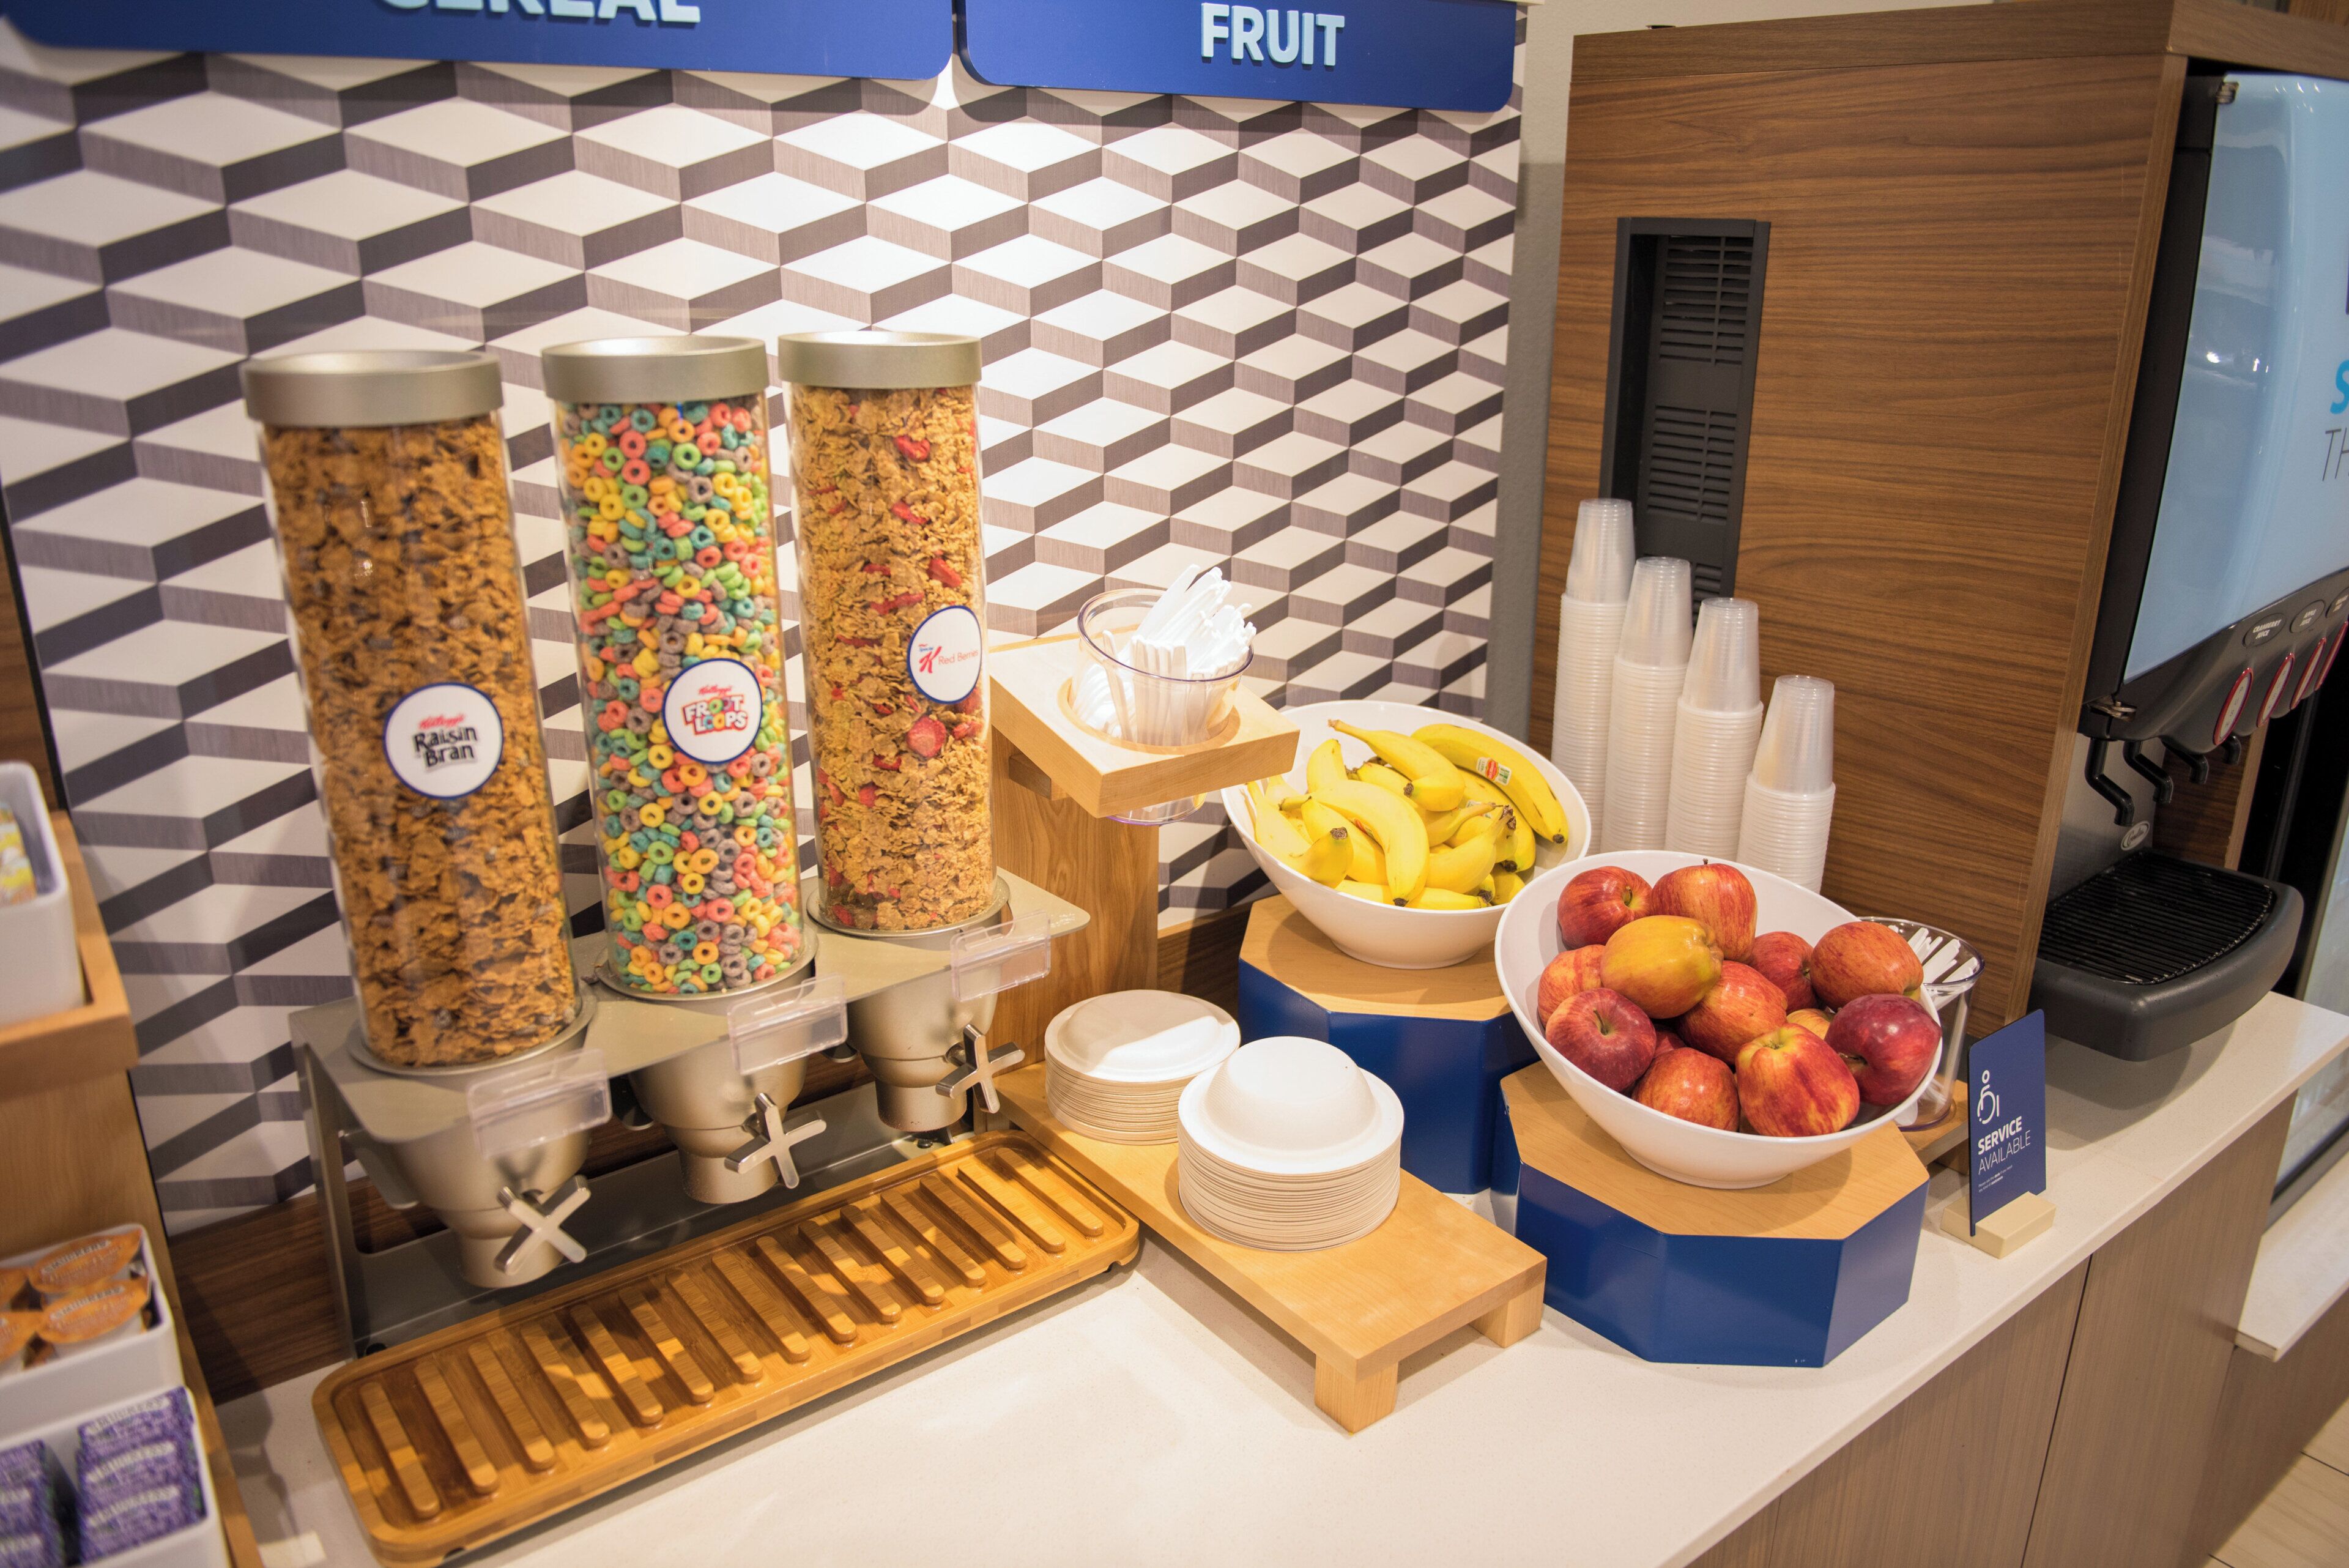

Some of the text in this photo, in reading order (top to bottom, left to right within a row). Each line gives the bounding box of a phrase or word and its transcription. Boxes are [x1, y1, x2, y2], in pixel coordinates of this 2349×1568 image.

[1201, 2, 1345, 66] FRUIT
[938, 654, 956, 666] Red
[694, 711, 748, 734] LOOPS
[414, 726, 478, 752] Raisin
[426, 745, 475, 767] Bran
[1978, 1116, 2022, 1155] SERVICE
[1978, 1130, 2031, 1175] AVAILABLE
